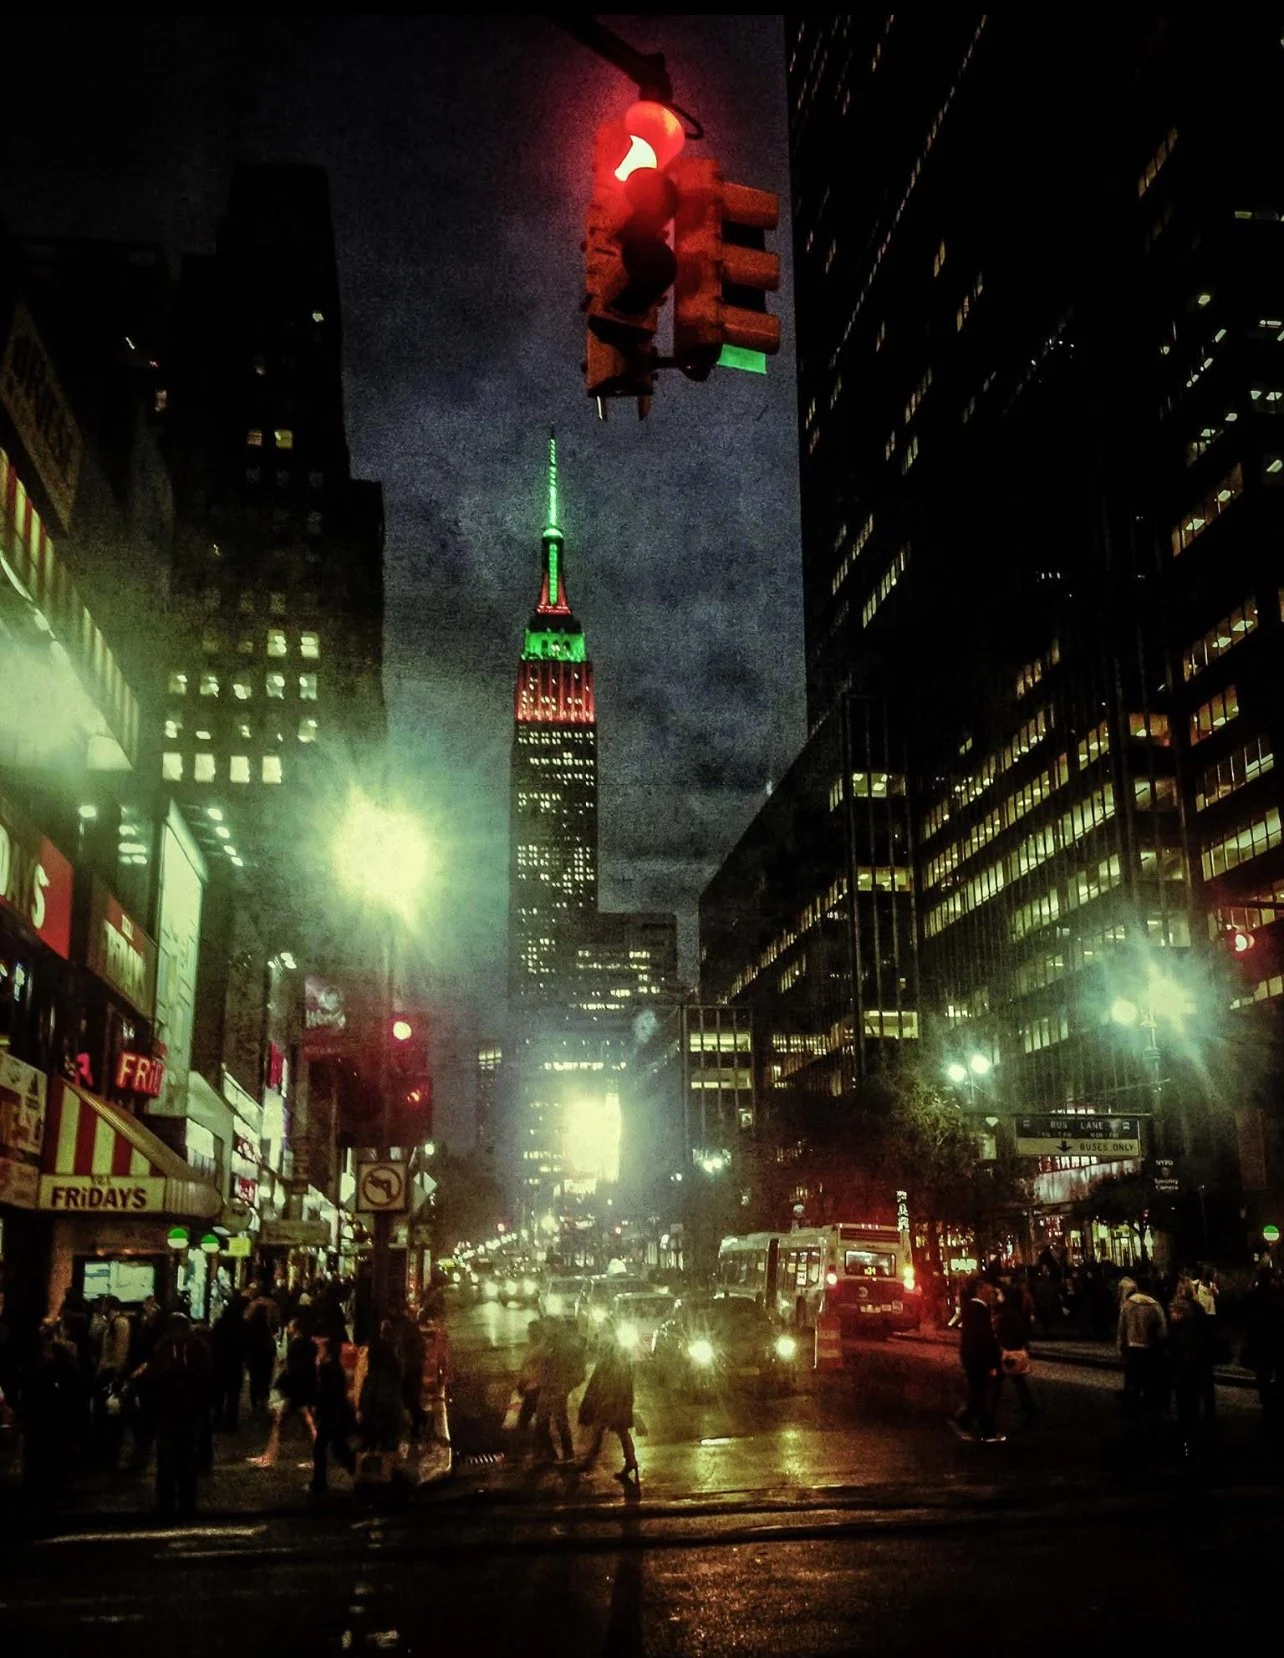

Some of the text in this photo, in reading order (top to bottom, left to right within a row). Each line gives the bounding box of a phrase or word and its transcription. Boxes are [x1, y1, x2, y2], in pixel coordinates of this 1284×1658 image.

[1050, 1120, 1104, 1130] BUS LANE
[1080, 1142, 1135, 1152] BUSES ONLY
